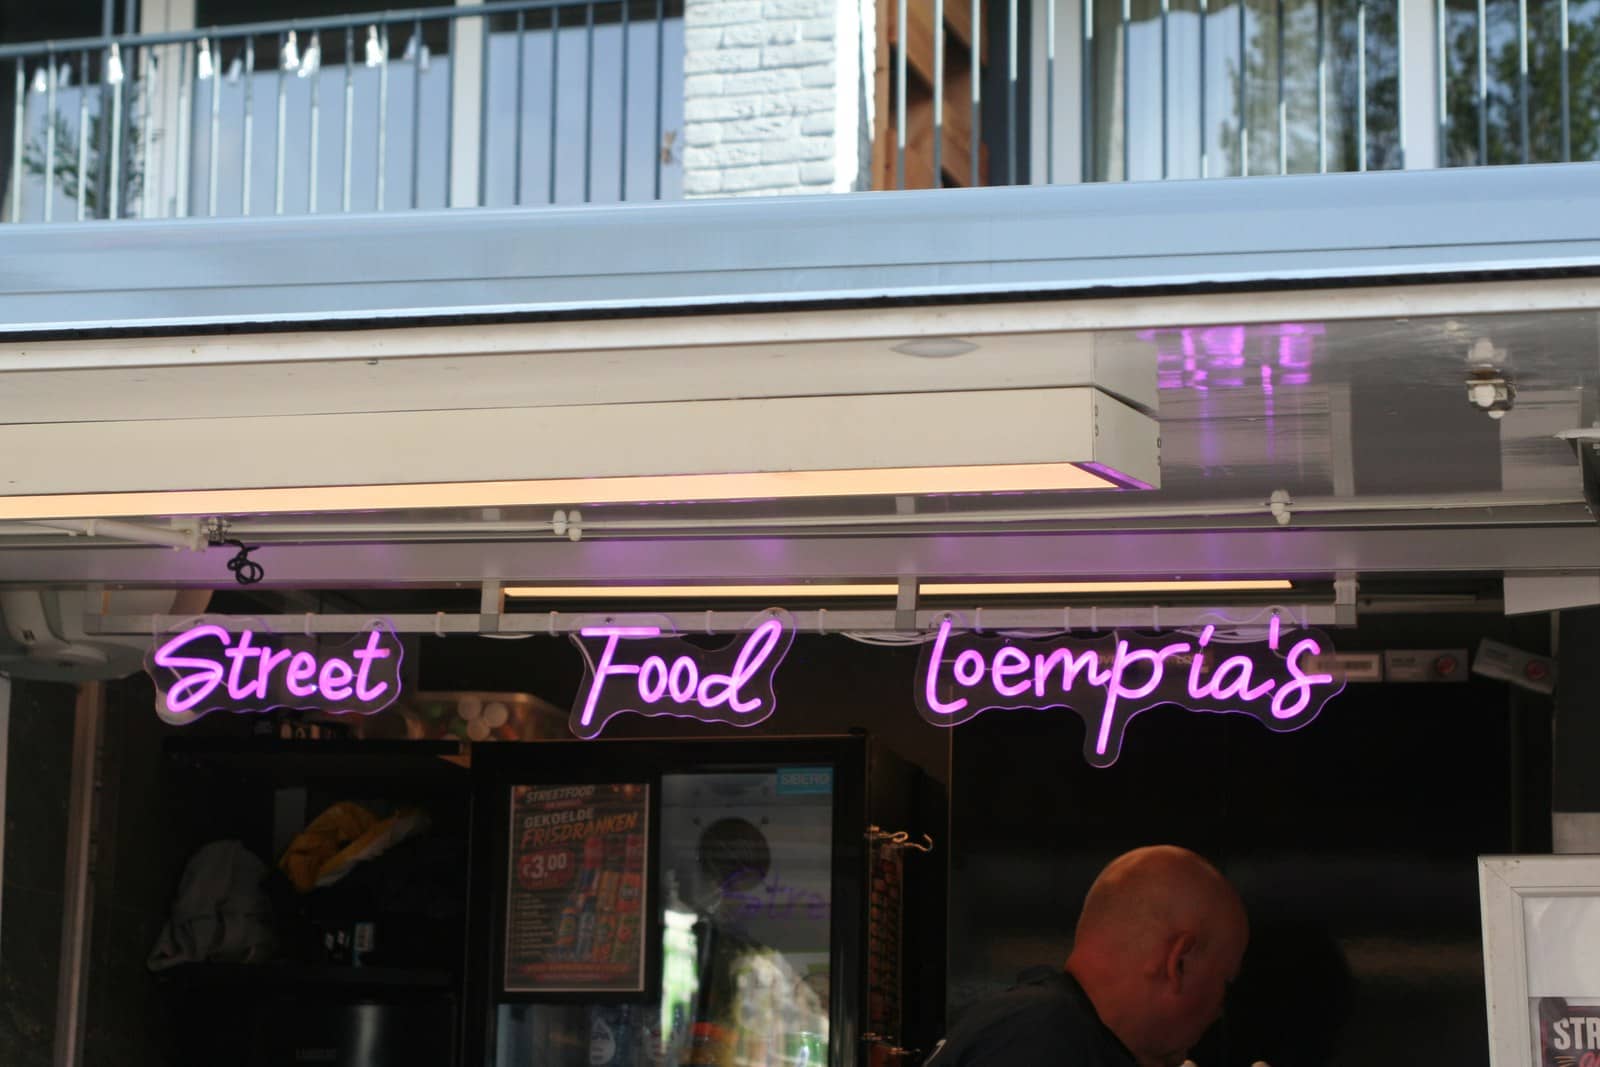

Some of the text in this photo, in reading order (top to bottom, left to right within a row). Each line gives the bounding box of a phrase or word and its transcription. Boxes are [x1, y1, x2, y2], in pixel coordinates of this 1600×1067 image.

[155, 625, 391, 712] Street
[581, 619, 783, 726] Food
[521, 812, 638, 849] FRISDRANKEN
[524, 807, 594, 829] GEKOELDE
[1553, 1016, 1600, 1050] STR
